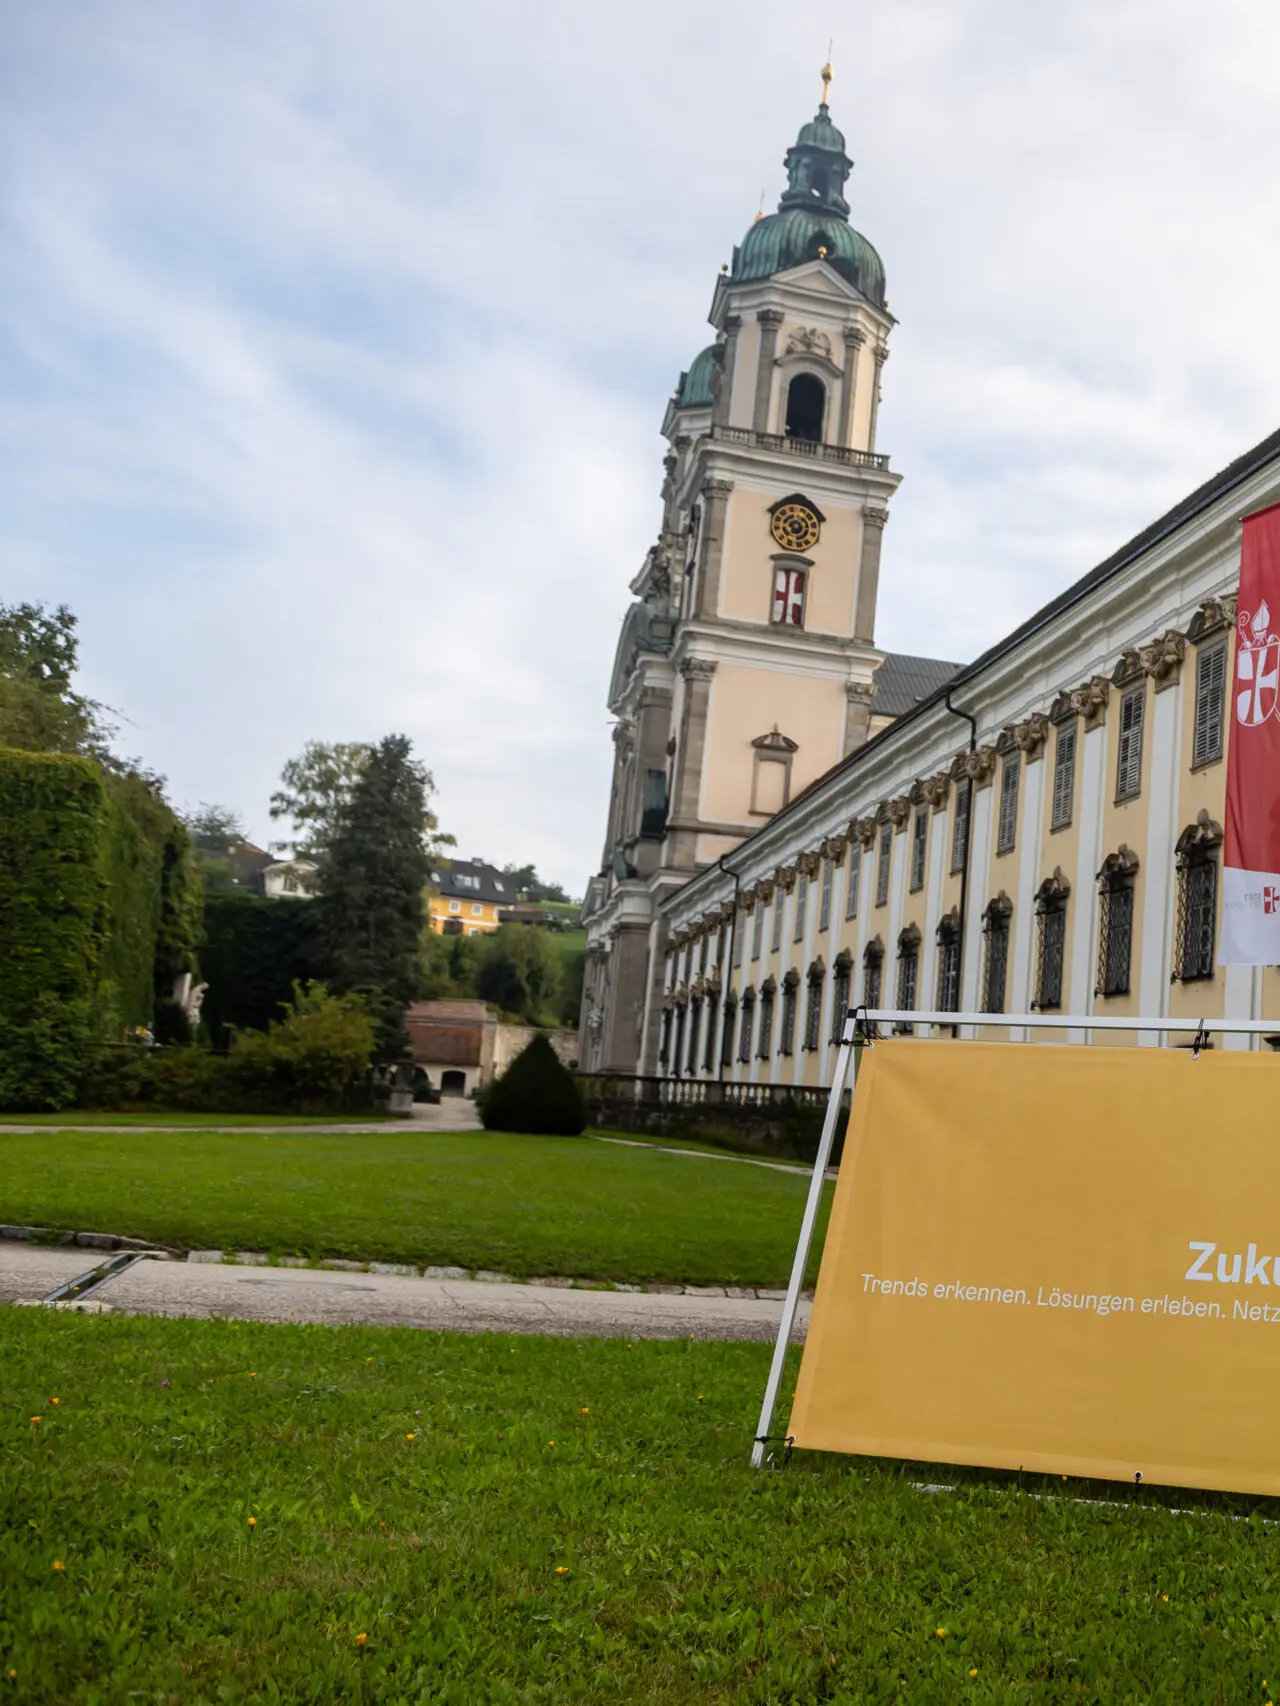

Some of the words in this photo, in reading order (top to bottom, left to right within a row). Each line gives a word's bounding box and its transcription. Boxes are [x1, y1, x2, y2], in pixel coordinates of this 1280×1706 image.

[861, 1273, 929, 1298] Trends
[933, 1280, 1031, 1305] erkennen.
[1037, 1287, 1135, 1316] Lösungen
[1140, 1294, 1226, 1319] erleben.
